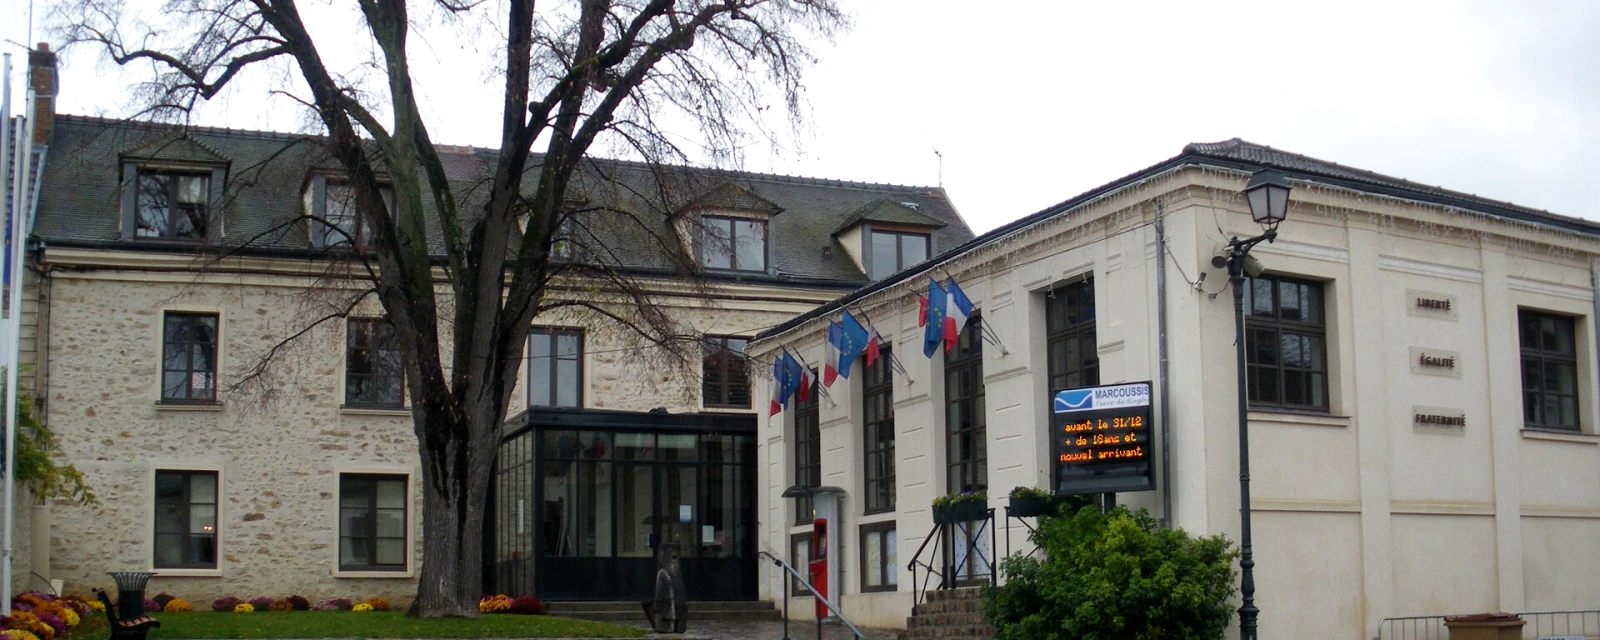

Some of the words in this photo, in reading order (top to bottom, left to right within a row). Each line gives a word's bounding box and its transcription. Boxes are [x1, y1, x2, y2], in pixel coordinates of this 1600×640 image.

[1416, 297, 1451, 311] LIBERTÉ
[1420, 353, 1455, 368] ÉGALITÉ
[1095, 386, 1149, 399] MARCOUSSIS
[1065, 420, 1093, 432] avant
[1097, 419, 1109, 430] le
[1113, 416, 1143, 428] 31/12
[1415, 413, 1466, 427] FRATERNITÉ
[1075, 435, 1088, 446] de
[1124, 432, 1137, 443] et
[1060, 449, 1093, 462] nouvel
[1098, 446, 1143, 459] arrivant
